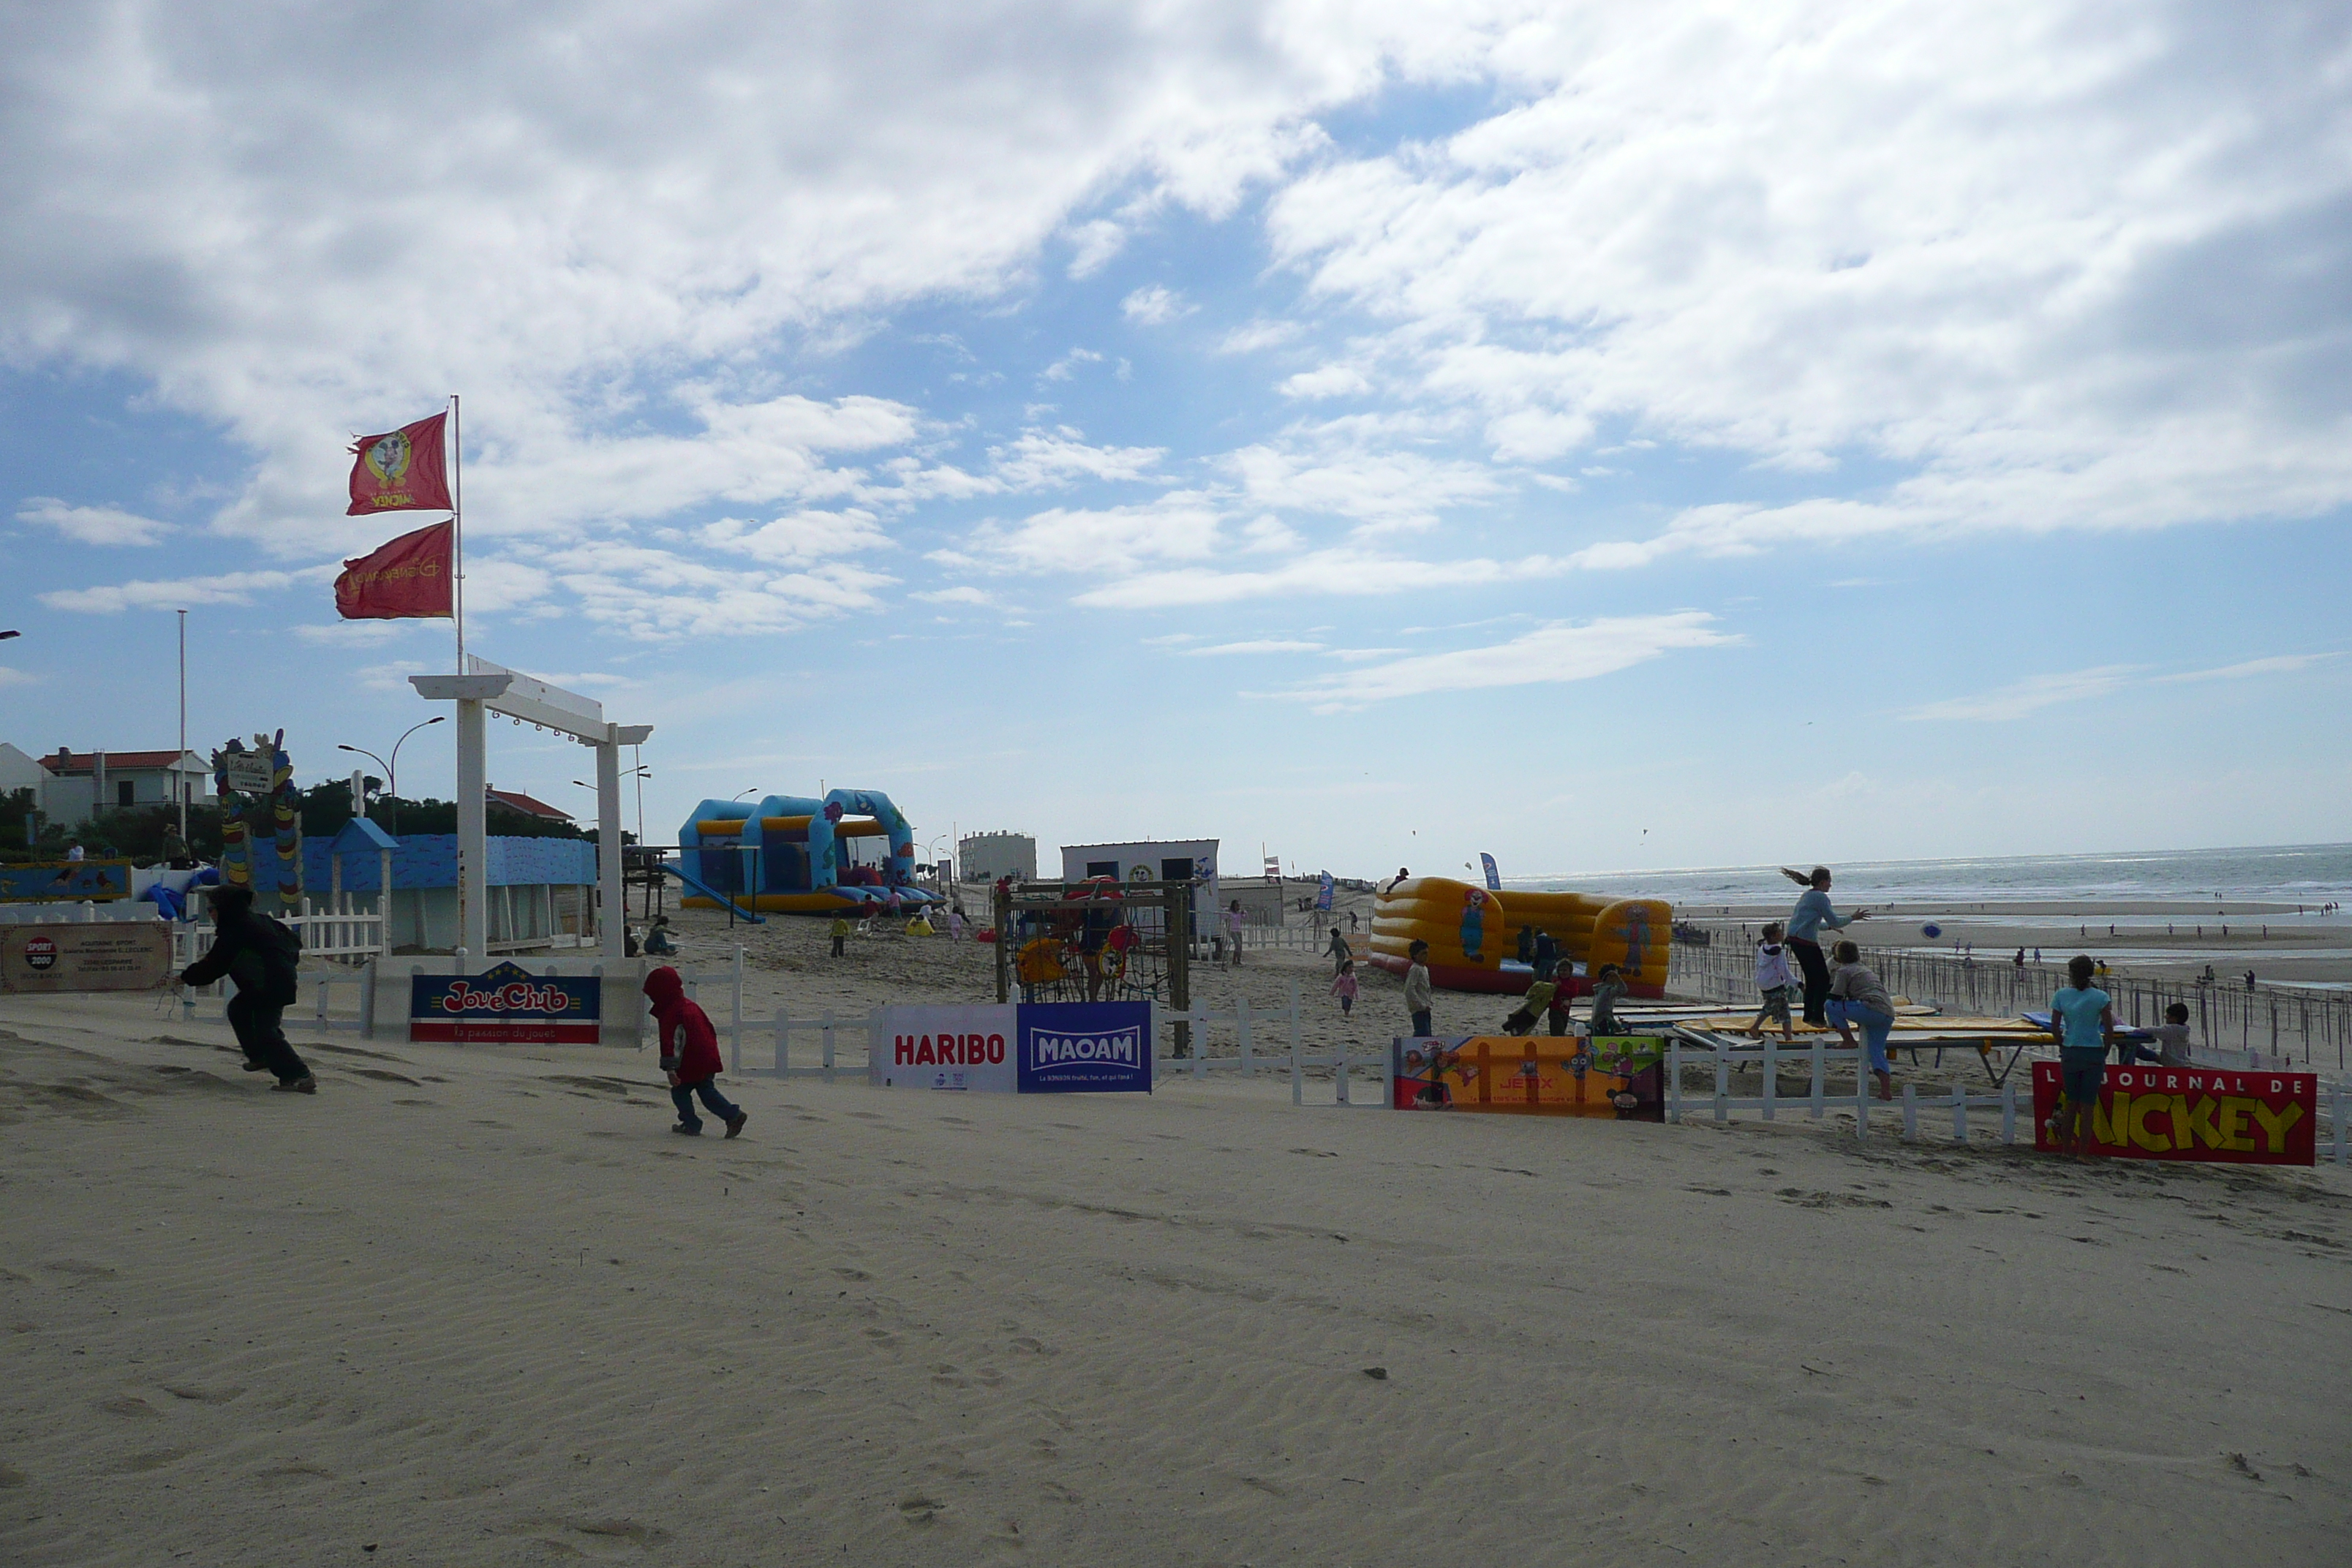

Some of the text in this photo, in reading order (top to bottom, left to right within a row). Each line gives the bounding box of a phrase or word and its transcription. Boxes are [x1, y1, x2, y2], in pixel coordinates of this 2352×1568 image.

[26, 942, 53, 951] SPORT
[31, 956, 52, 965] 2000
[453, 1026, 556, 1041] la passion du jouet
[895, 1033, 1005, 1066] HARIBO
[1039, 1035, 1133, 1063] MAOAM
[1500, 1077, 1553, 1089] JETIX
[2100, 1071, 2245, 1093] JOURNAL
[2270, 1079, 2302, 1094] DE
